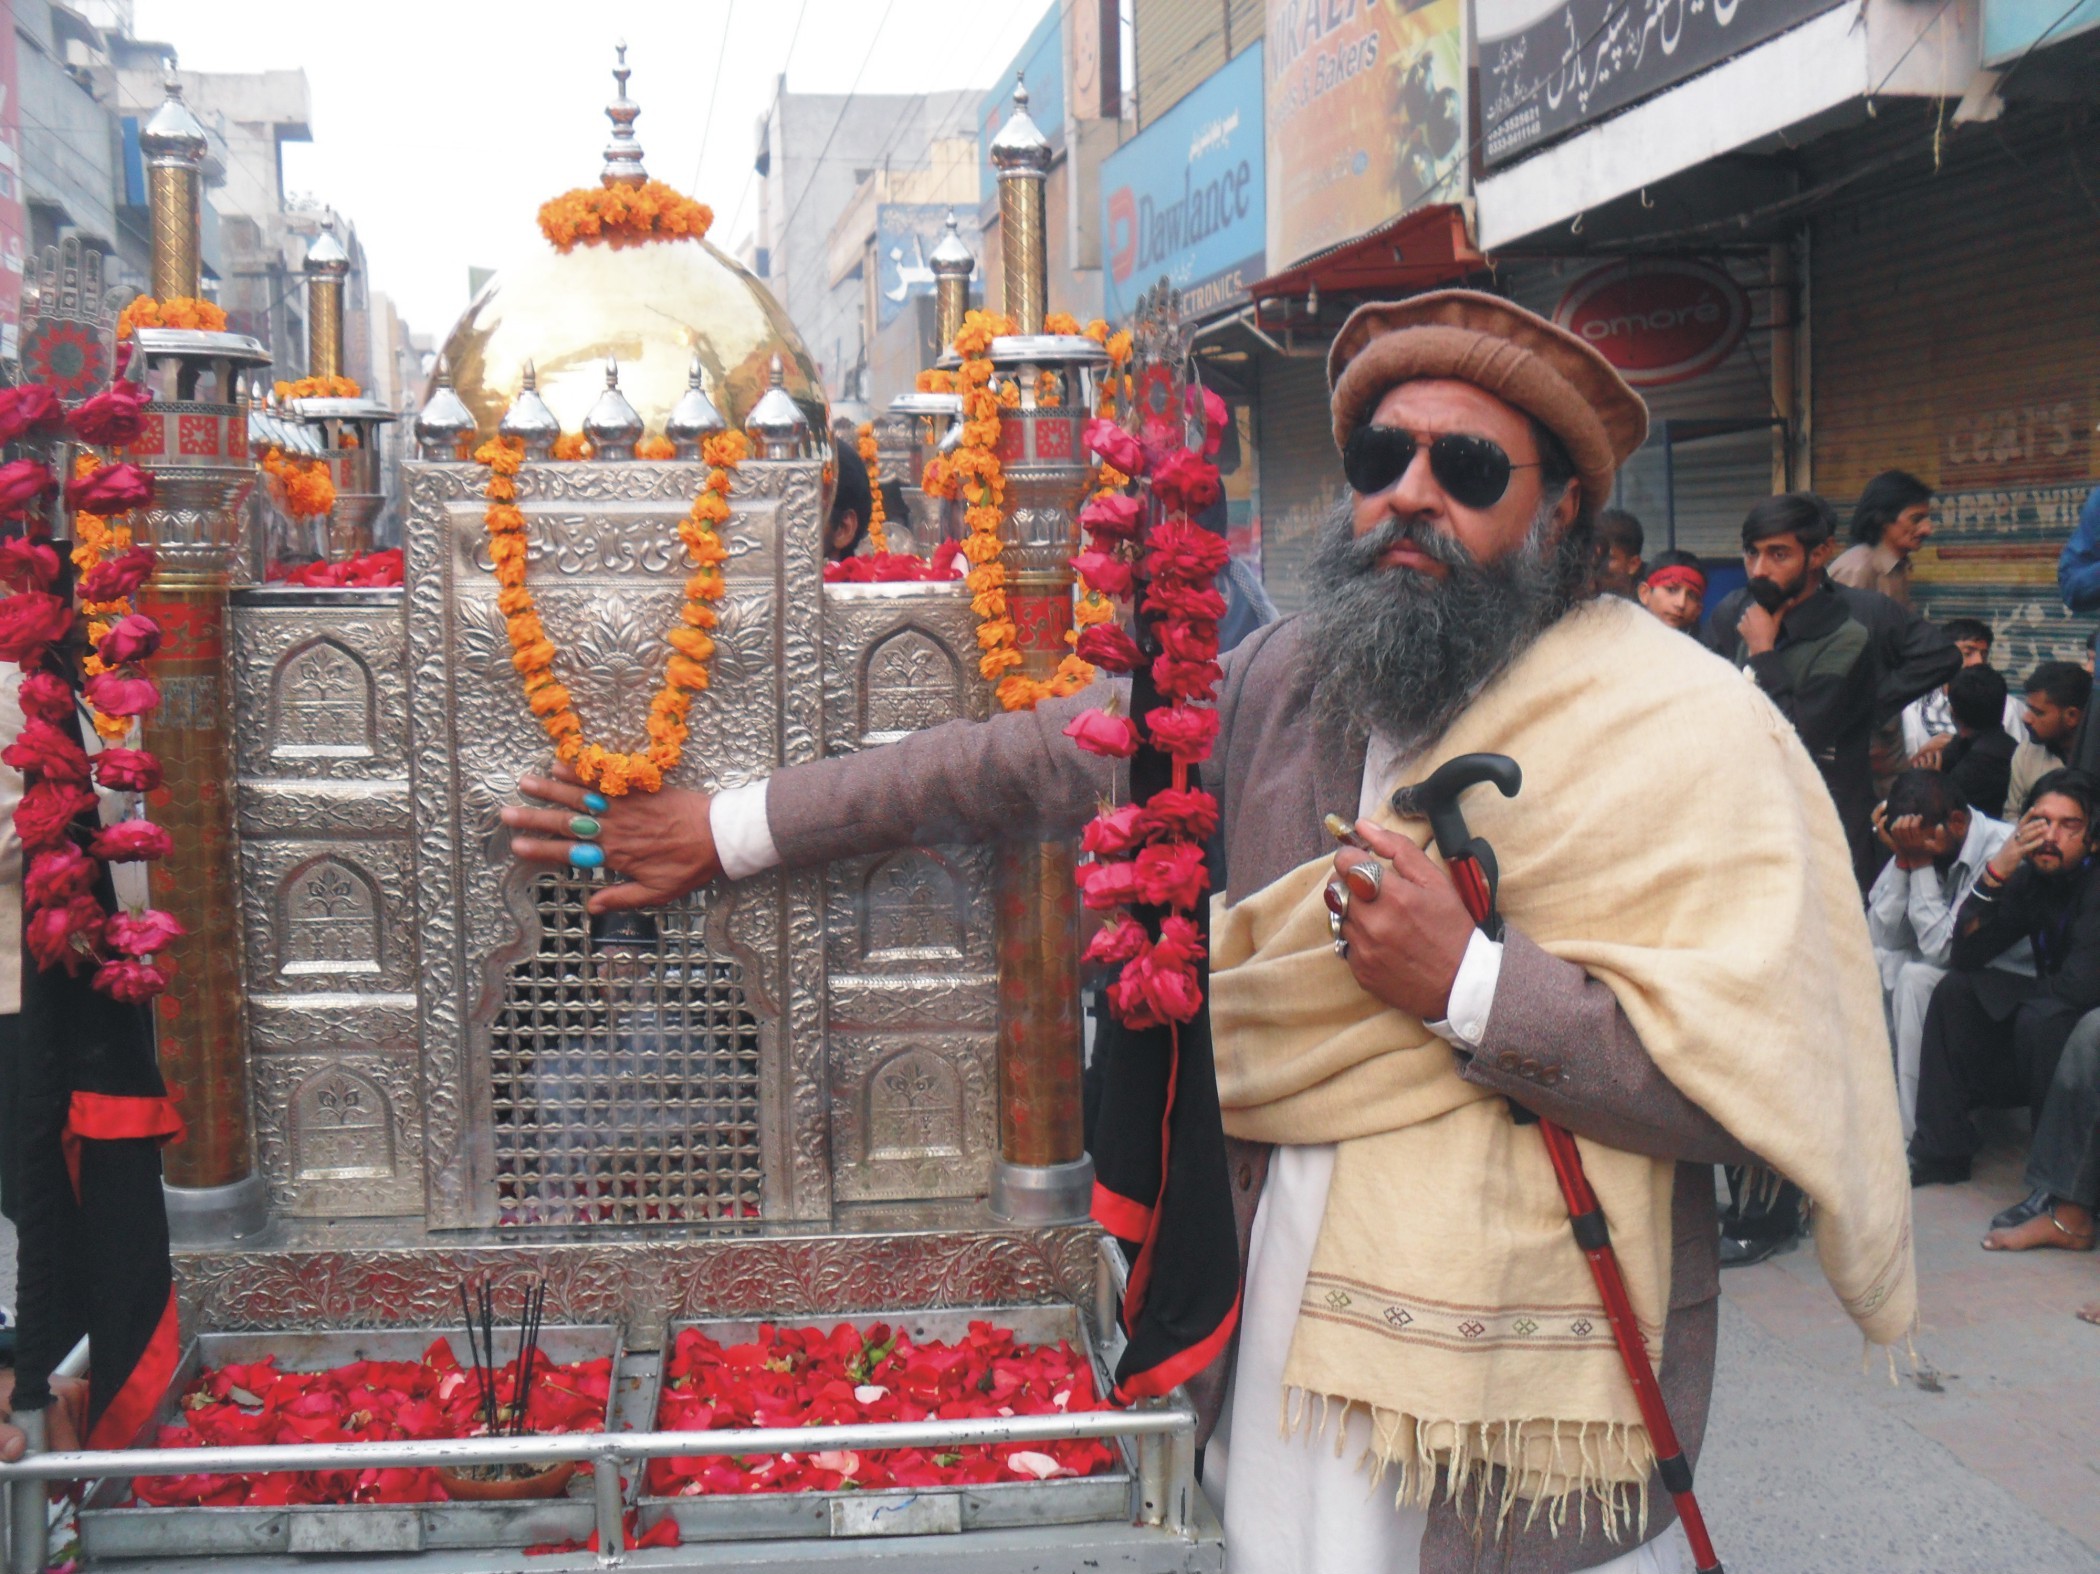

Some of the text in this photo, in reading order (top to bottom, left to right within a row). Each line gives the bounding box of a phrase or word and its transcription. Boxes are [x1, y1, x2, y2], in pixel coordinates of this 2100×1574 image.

[1314, 31, 1378, 97] Bakers
[1136, 159, 1251, 272] Dawlance
[1180, 270, 1243, 317] CTRONICS
